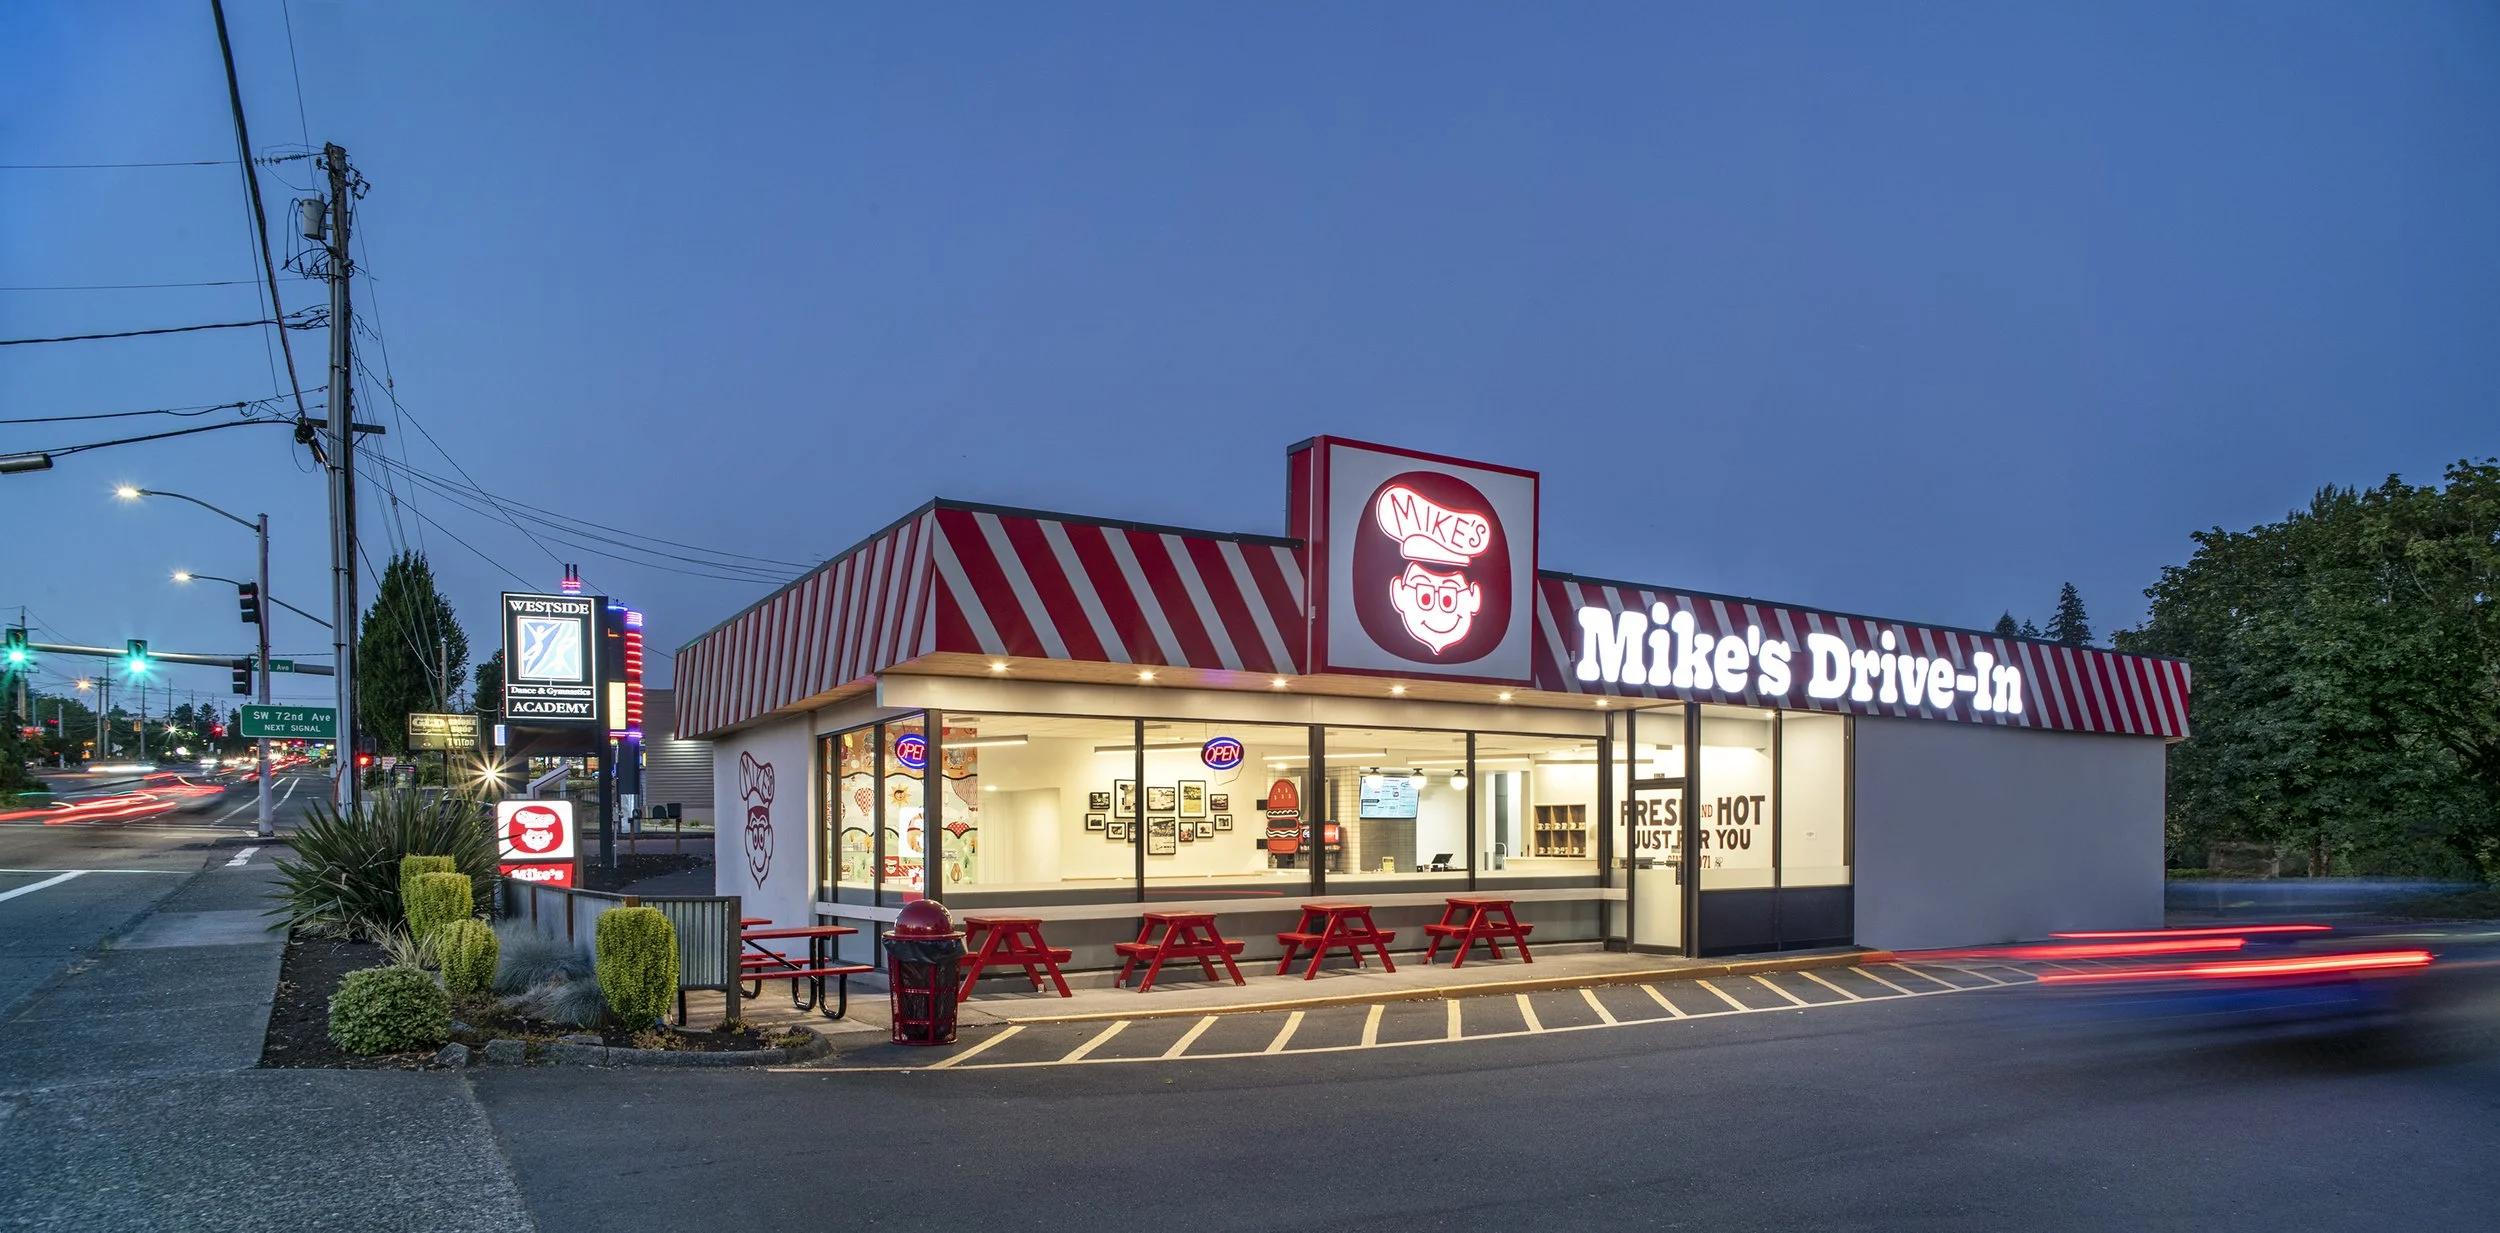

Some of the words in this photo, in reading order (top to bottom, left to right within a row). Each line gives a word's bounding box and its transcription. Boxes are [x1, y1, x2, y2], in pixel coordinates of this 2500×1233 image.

[1390, 493, 1487, 549] MIKE'S
[509, 600, 590, 614] WESTSIDE
[1576, 601, 1792, 697] Mike's
[1806, 629, 2024, 714] Drive-In
[276, 663, 290, 671] Ave
[510, 686, 537, 694] Dance
[546, 687, 591, 696] Gymnastics
[512, 702, 590, 713] ACADEMY
[253, 711, 269, 720] SW
[275, 711, 304, 721] 72nd
[311, 713, 331, 721] Ave
[1205, 745, 1240, 762] OPEN
[1701, 804, 1713, 818] ND
[1717, 795, 1765, 826] HOT
[1715, 828, 1751, 850] YOU
